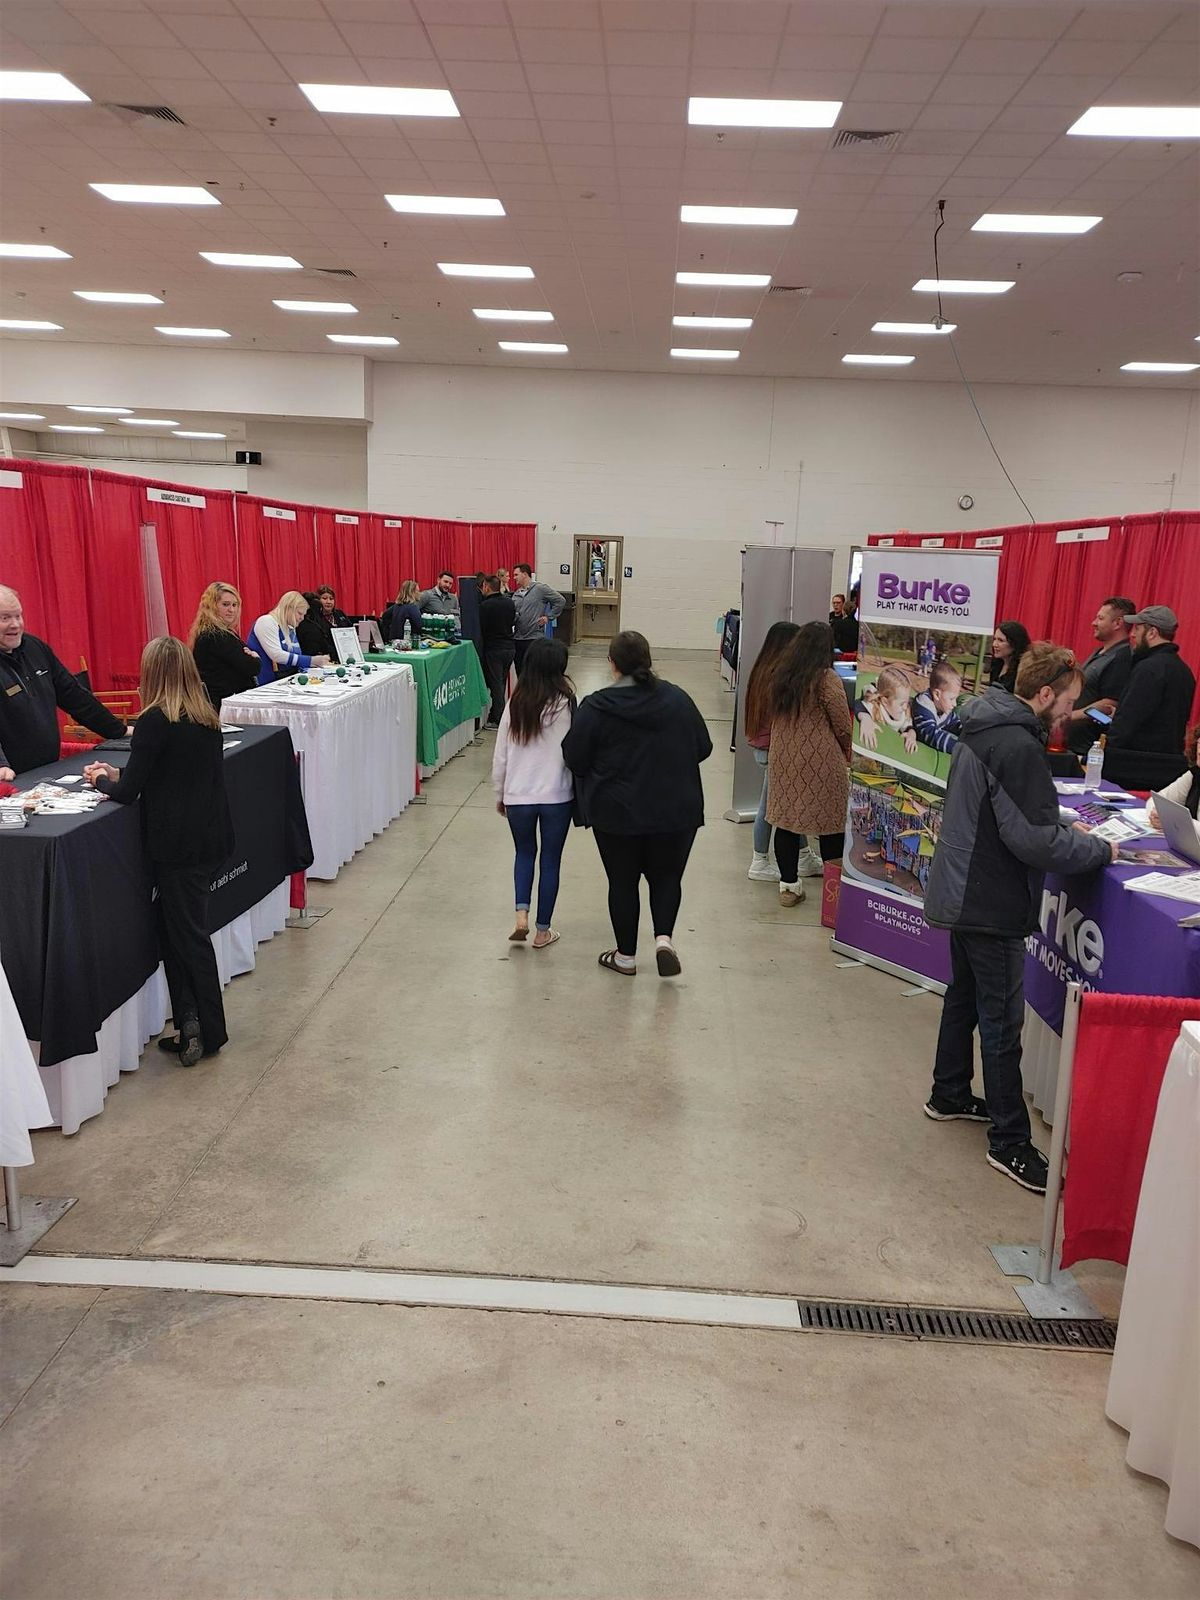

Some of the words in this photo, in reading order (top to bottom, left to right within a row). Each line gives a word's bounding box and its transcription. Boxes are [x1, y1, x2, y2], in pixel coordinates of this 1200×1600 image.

[877, 572, 970, 605] Burke
[876, 600, 896, 610] PLAY
[898, 602, 918, 612] THAT
[919, 604, 949, 614] MOVES
[951, 606, 970, 616] YOU
[1039, 888, 1104, 974] rke
